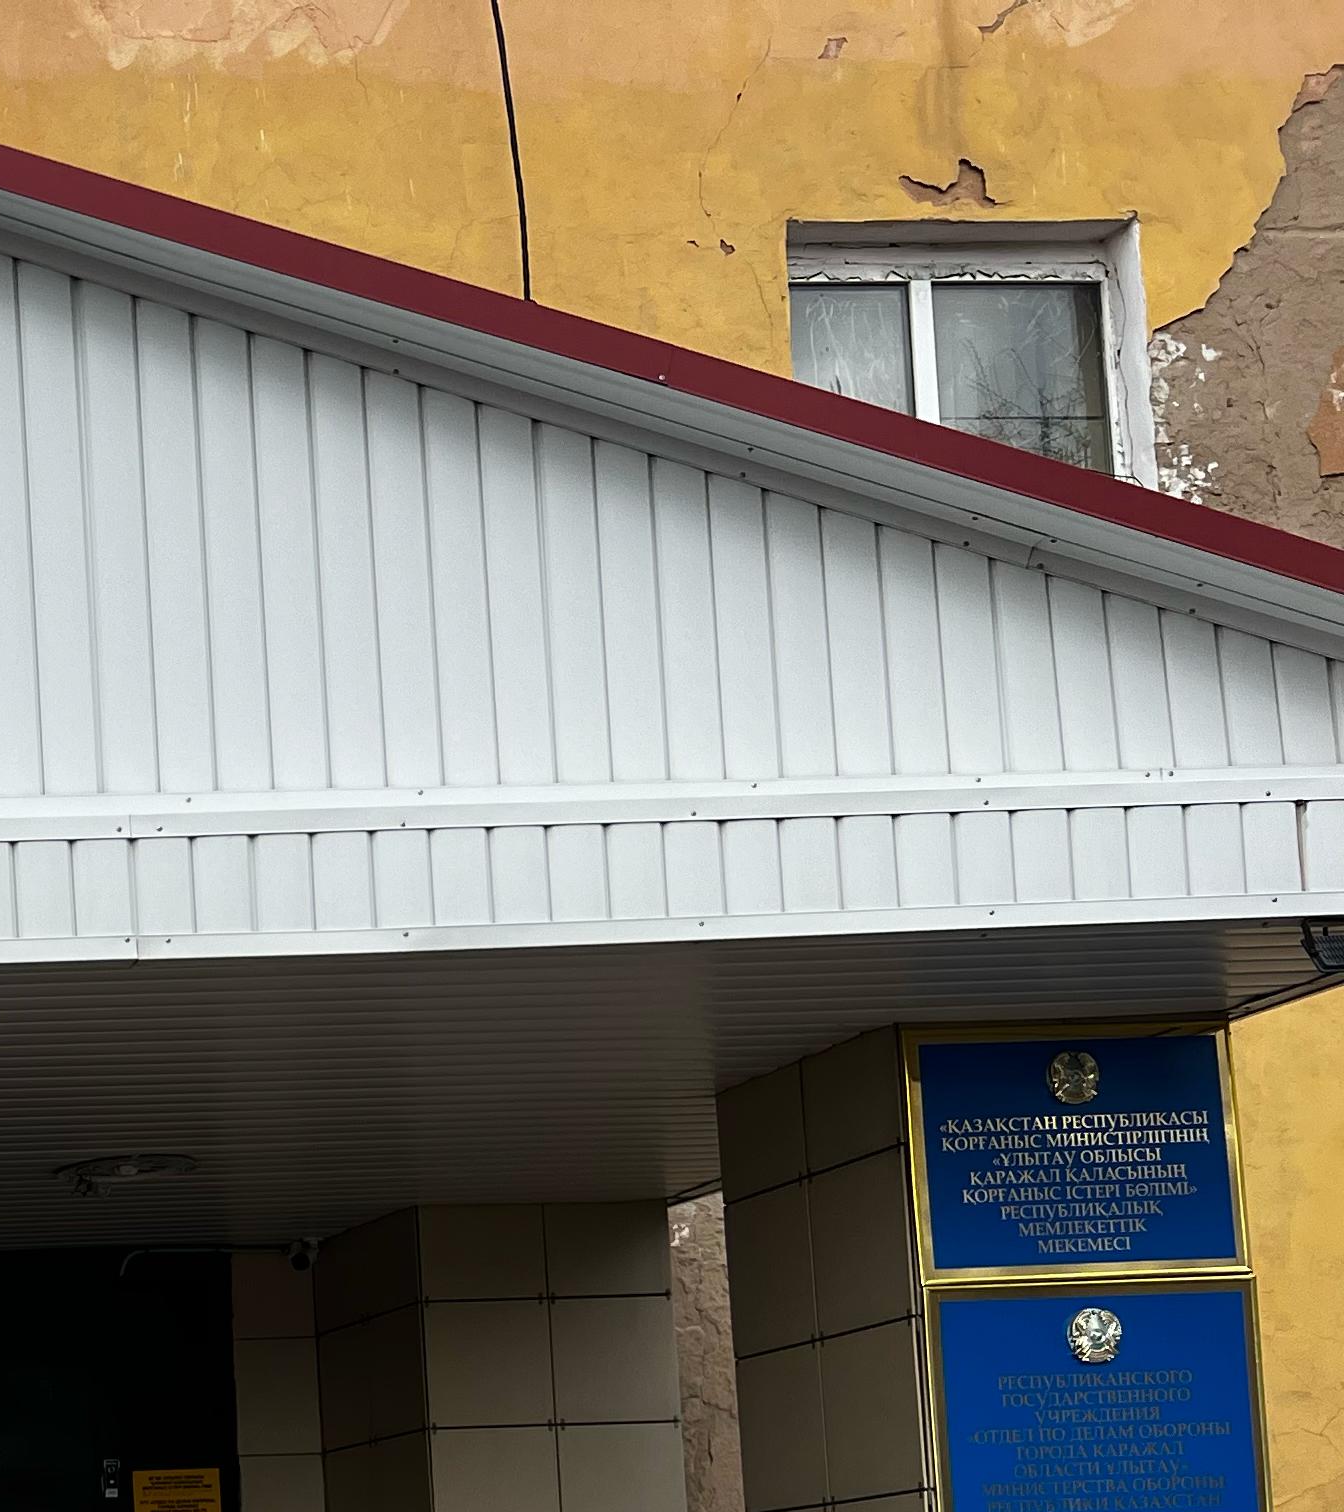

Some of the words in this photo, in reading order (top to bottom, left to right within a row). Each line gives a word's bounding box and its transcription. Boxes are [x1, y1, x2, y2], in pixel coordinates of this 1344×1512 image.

[940, 1117, 1058, 1135] «ҚАЗАҚСТАН
[1062, 1111, 1209, 1131] РЕСПУБЛИКАСЫ
[942, 1134, 1042, 1152] ҚОРҒАНЫС
[993, 1150, 1073, 1169] «ҰЛЫТАУ
[1081, 1148, 1162, 1164] ОБЛЫСЫ
[970, 1169, 1061, 1186] ҚАРАЖАЛ
[1066, 1164, 1186, 1183] ҚАЛАСЫНЫҢ
[963, 1187, 1062, 1205] ҚОРҒАНЫС
[1066, 1185, 1120, 1200] ІСТЕРІ
[1126, 1181, 1197, 1198] БӨЛІМІ»
[1018, 1219, 1147, 1238] МЕМЛЕКЕТТІК
[1038, 1237, 1131, 1253] МЕКЕМЕСІ
[998, 1369, 1193, 1391] РЕСПУБЛИКАНСКОГО
[1002, 1387, 1191, 1408] ГОСУДАРСТВЕННОГО
[1034, 1407, 1161, 1424] УЧРЕЖДЕНИЯ
[1039, 1426, 1066, 1441] ПО
[1070, 1424, 1134, 1442] ДЕЛАМ
[1139, 1421, 1231, 1437] ОБОРОНЫ
[1016, 1445, 1088, 1461] ГОРОДА
[1093, 1441, 1184, 1457] КАРАЖАЛ
